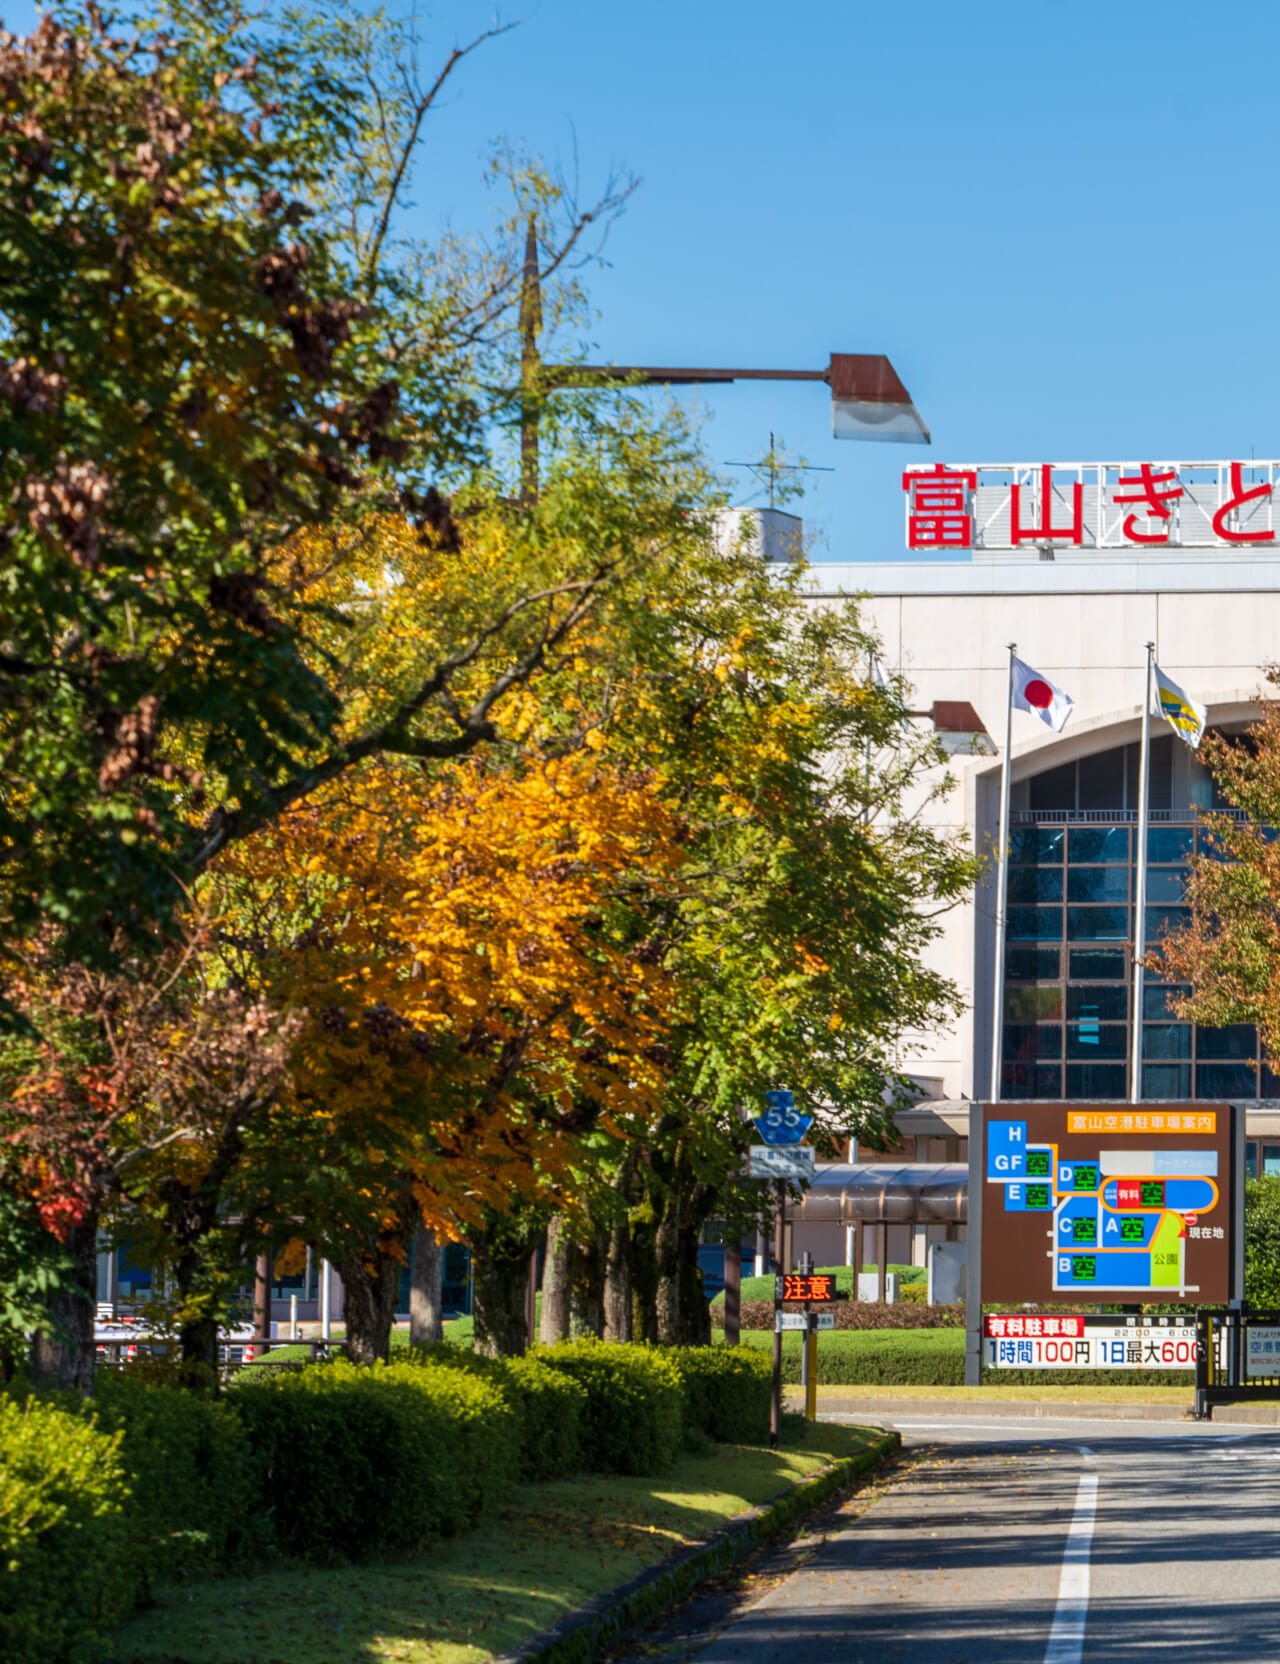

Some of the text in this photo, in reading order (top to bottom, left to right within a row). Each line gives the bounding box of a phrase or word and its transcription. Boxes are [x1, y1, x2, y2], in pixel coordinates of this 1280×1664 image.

[766, 1106, 800, 1128] 55
[1073, 1115, 1212, 1130] 富山空港駐車場案内
[1009, 1126, 1021, 1141] H
[1026, 1152, 1049, 1176] 空
[1060, 1166, 1073, 1182] D
[1074, 1166, 1097, 1190] 空
[1009, 1184, 1021, 1200] E
[1026, 1184, 1049, 1208] 空
[1119, 1189, 1139, 1200] 有料
[1141, 1182, 1164, 1206] 空
[1059, 1217, 1072, 1233] C
[1073, 1217, 1096, 1241] 空
[1105, 1218, 1118, 1233] A
[1120, 1217, 1144, 1241] 空
[1189, 1226, 1224, 1239] 現在地
[1059, 1257, 1071, 1272] B
[1072, 1256, 1096, 1280] 空
[1154, 1253, 1178, 1265] 公園
[784, 1275, 831, 1300] 注意
[989, 1318, 1078, 1336] 有料駐車場
[989, 1340, 1090, 1364] 1時間100円
